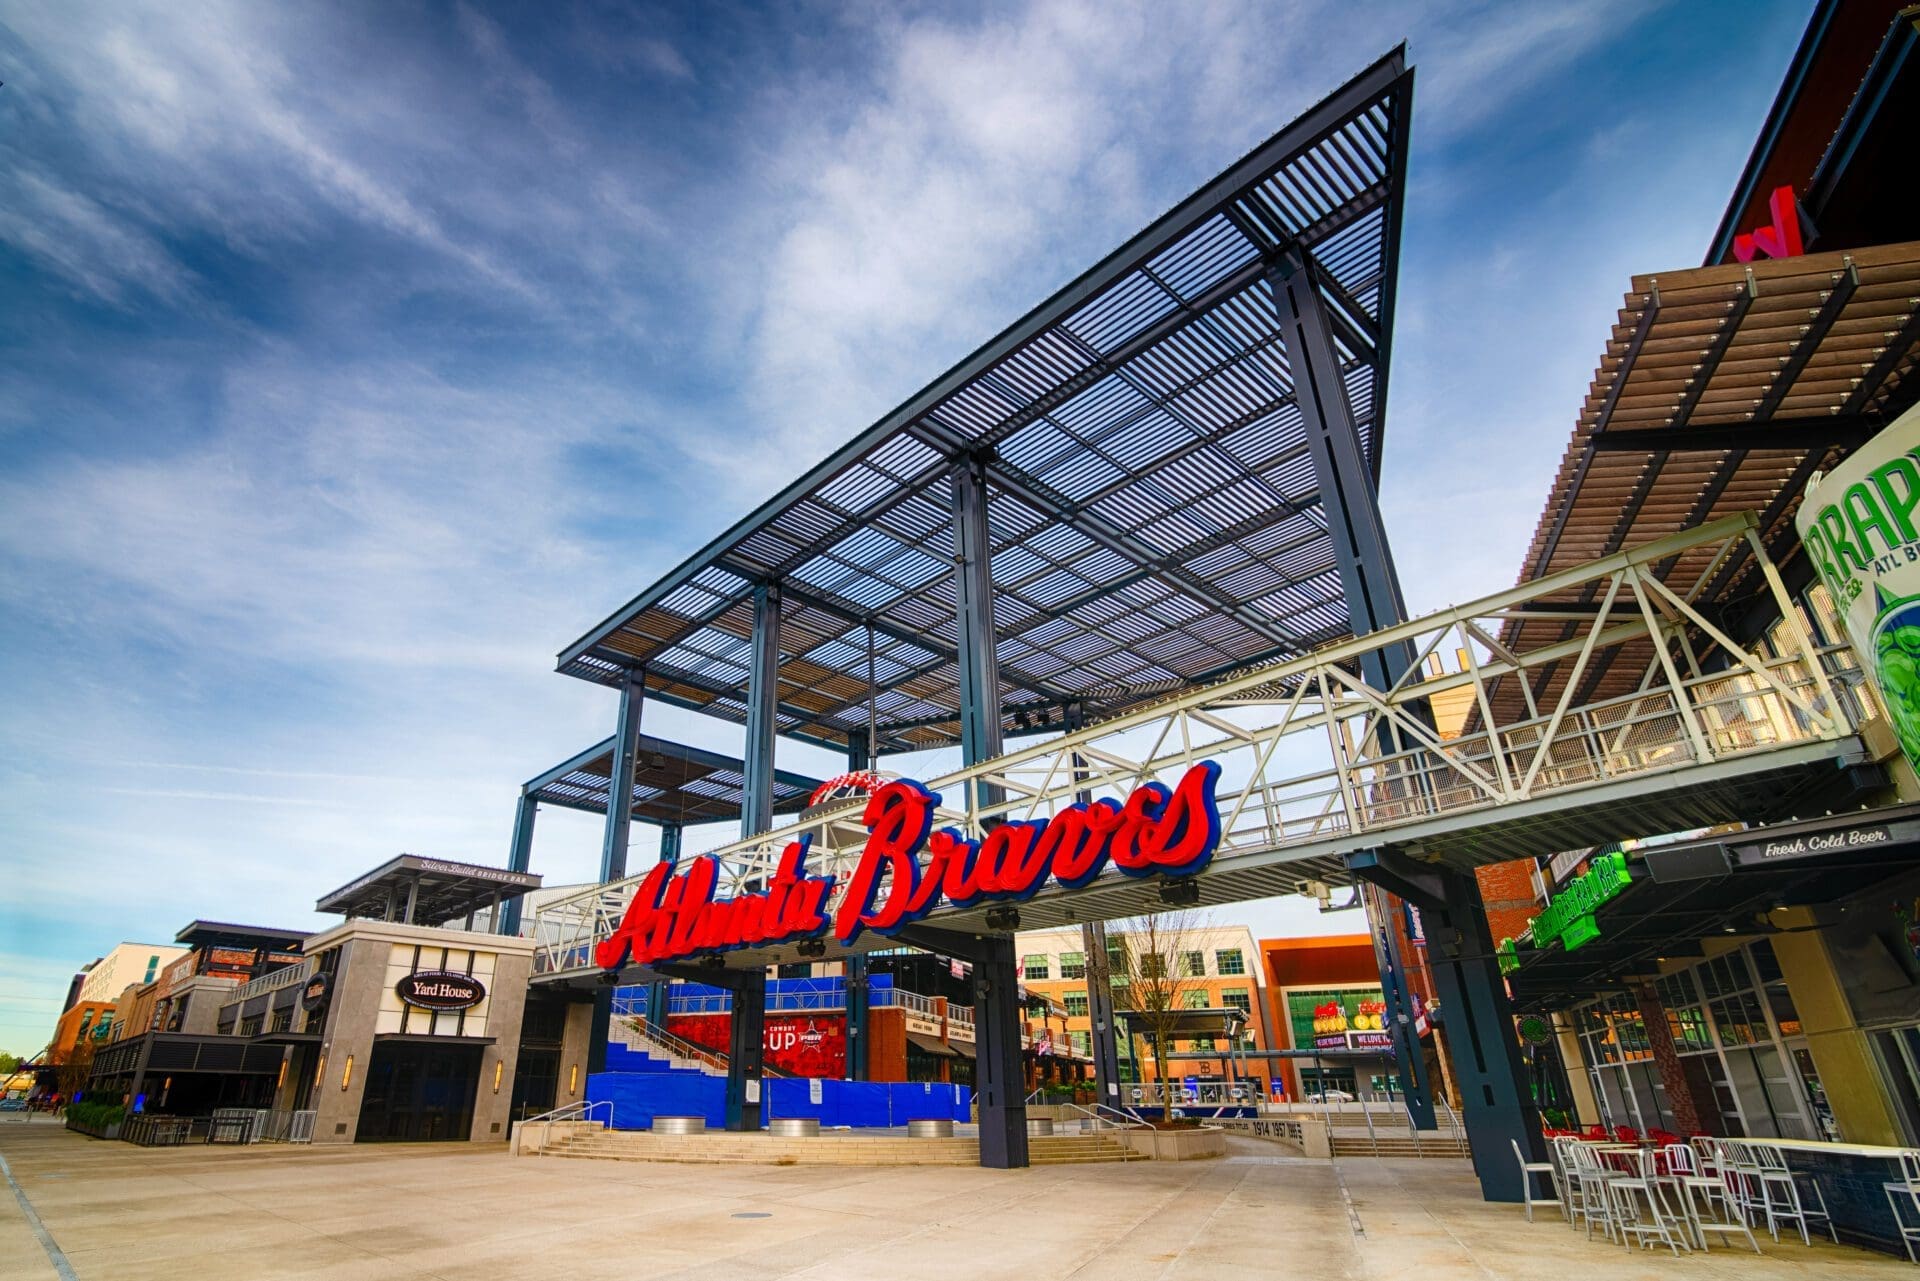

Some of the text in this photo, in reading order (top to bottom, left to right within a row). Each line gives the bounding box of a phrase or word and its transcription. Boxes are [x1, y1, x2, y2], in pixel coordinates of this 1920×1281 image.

[1804, 446, 1920, 592] RRAP
[1874, 553, 1902, 577] ATL
[1765, 830, 1886, 857] Fresh Cold Beer
[420, 860, 448, 872] Silver
[448, 865, 477, 876] Bullet
[477, 871, 508, 881] BRIDGE
[596, 760, 1222, 971] Atlanta Braves
[413, 982, 473, 998] Yard House
[769, 1033, 796, 1051] UP
[1253, 1121, 1270, 1137] 1914
[1272, 1122, 1287, 1138] 1957
